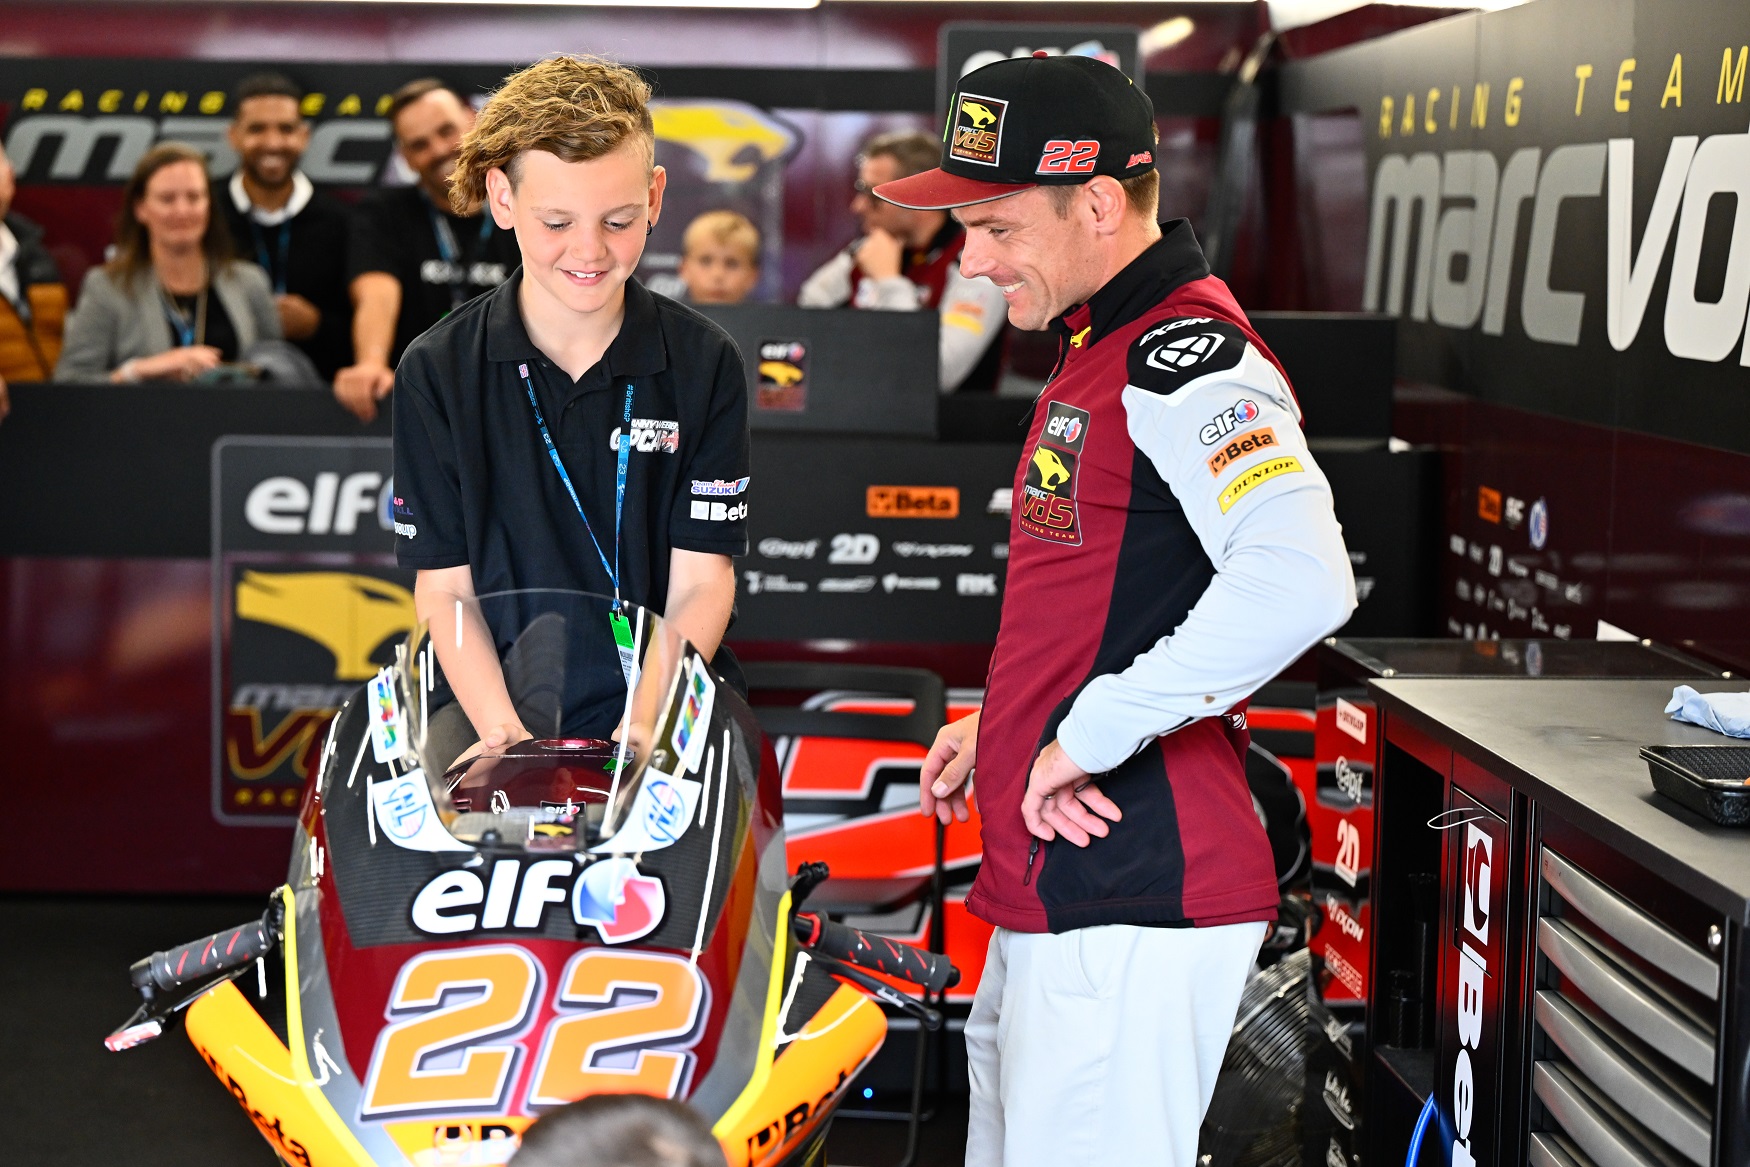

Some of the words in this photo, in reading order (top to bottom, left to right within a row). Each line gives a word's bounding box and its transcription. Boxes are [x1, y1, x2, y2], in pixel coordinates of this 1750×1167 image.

[21, 87, 226, 115] RACING
[1379, 77, 1524, 140] RACING
[1575, 45, 1749, 116] TEAM
[1036, 140, 1100, 175] 22
[1047, 416, 1069, 437] elf
[1201, 405, 1239, 446] elf
[1224, 432, 1275, 462] Beta
[692, 486, 735, 494] SUZUKI
[1024, 484, 1048, 500] marc
[1232, 460, 1295, 496] DUNLOP
[245, 471, 381, 534] elf
[1021, 520, 1045, 534] RACING
[1049, 530, 1075, 540] TEAM
[828, 533, 881, 564] 2D
[411, 859, 574, 934] elf
[354, 943, 713, 1127] 22
